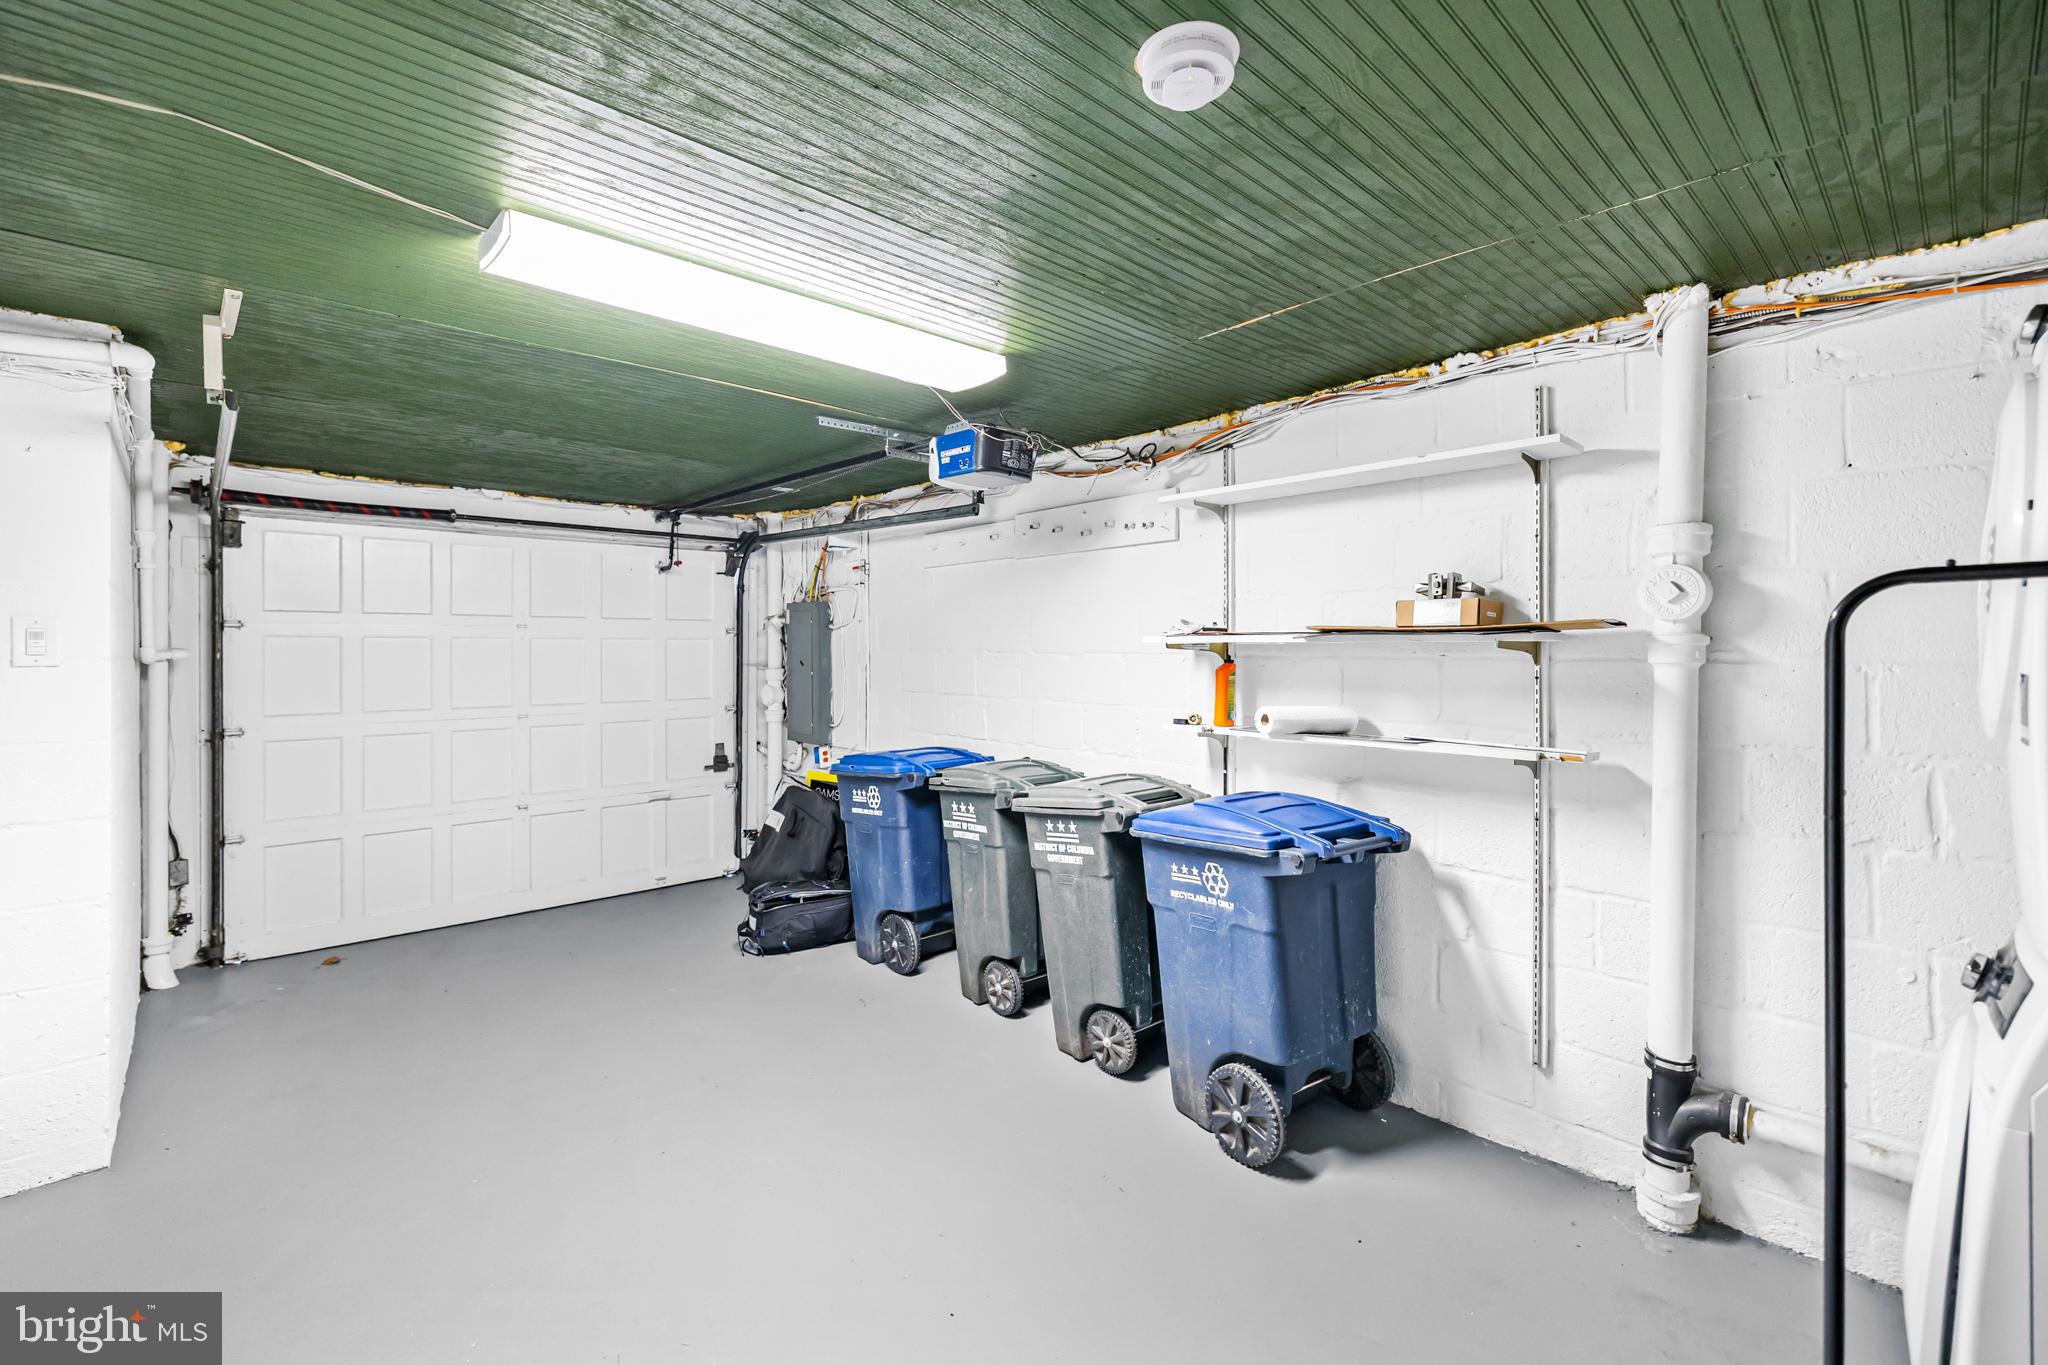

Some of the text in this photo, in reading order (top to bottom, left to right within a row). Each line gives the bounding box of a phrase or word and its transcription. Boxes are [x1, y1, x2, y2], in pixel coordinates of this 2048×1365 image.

[1034, 842, 1095, 856] DISTRICT OF COLUMBIA
[1047, 853, 1084, 865] GOVERNMENT
[1170, 889, 1235, 911] RECYCLABLES ONLY
